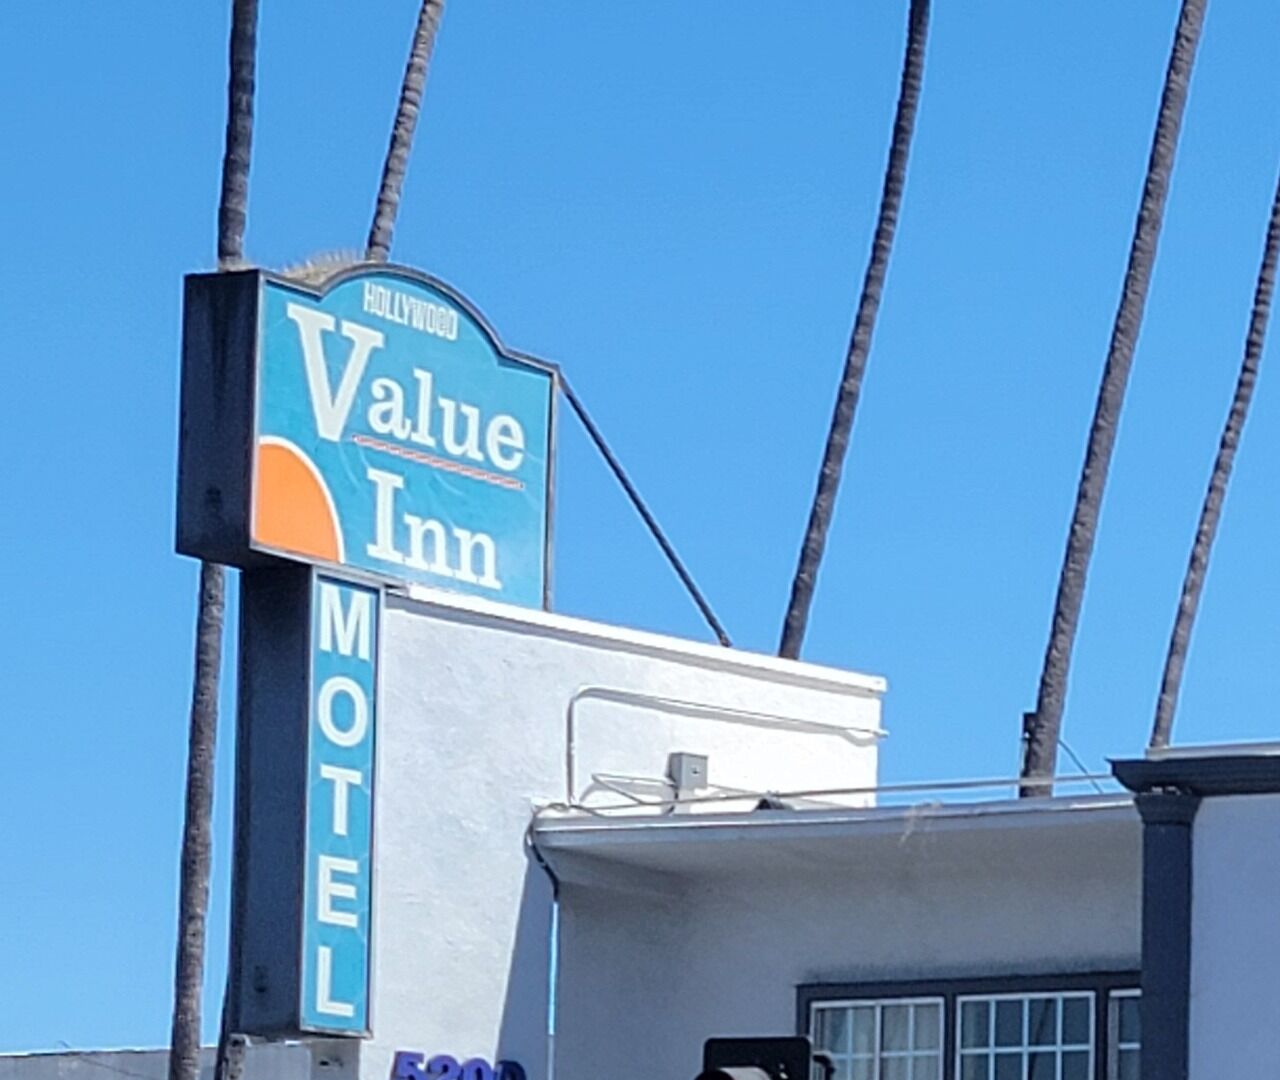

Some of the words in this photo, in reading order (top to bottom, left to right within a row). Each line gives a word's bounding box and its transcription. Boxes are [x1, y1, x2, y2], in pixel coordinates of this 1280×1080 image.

[363, 281, 458, 341] HOLLYWOOD
[287, 303, 525, 471] Value
[367, 469, 500, 589] Inn
[316, 584, 371, 1017] MOTEL
